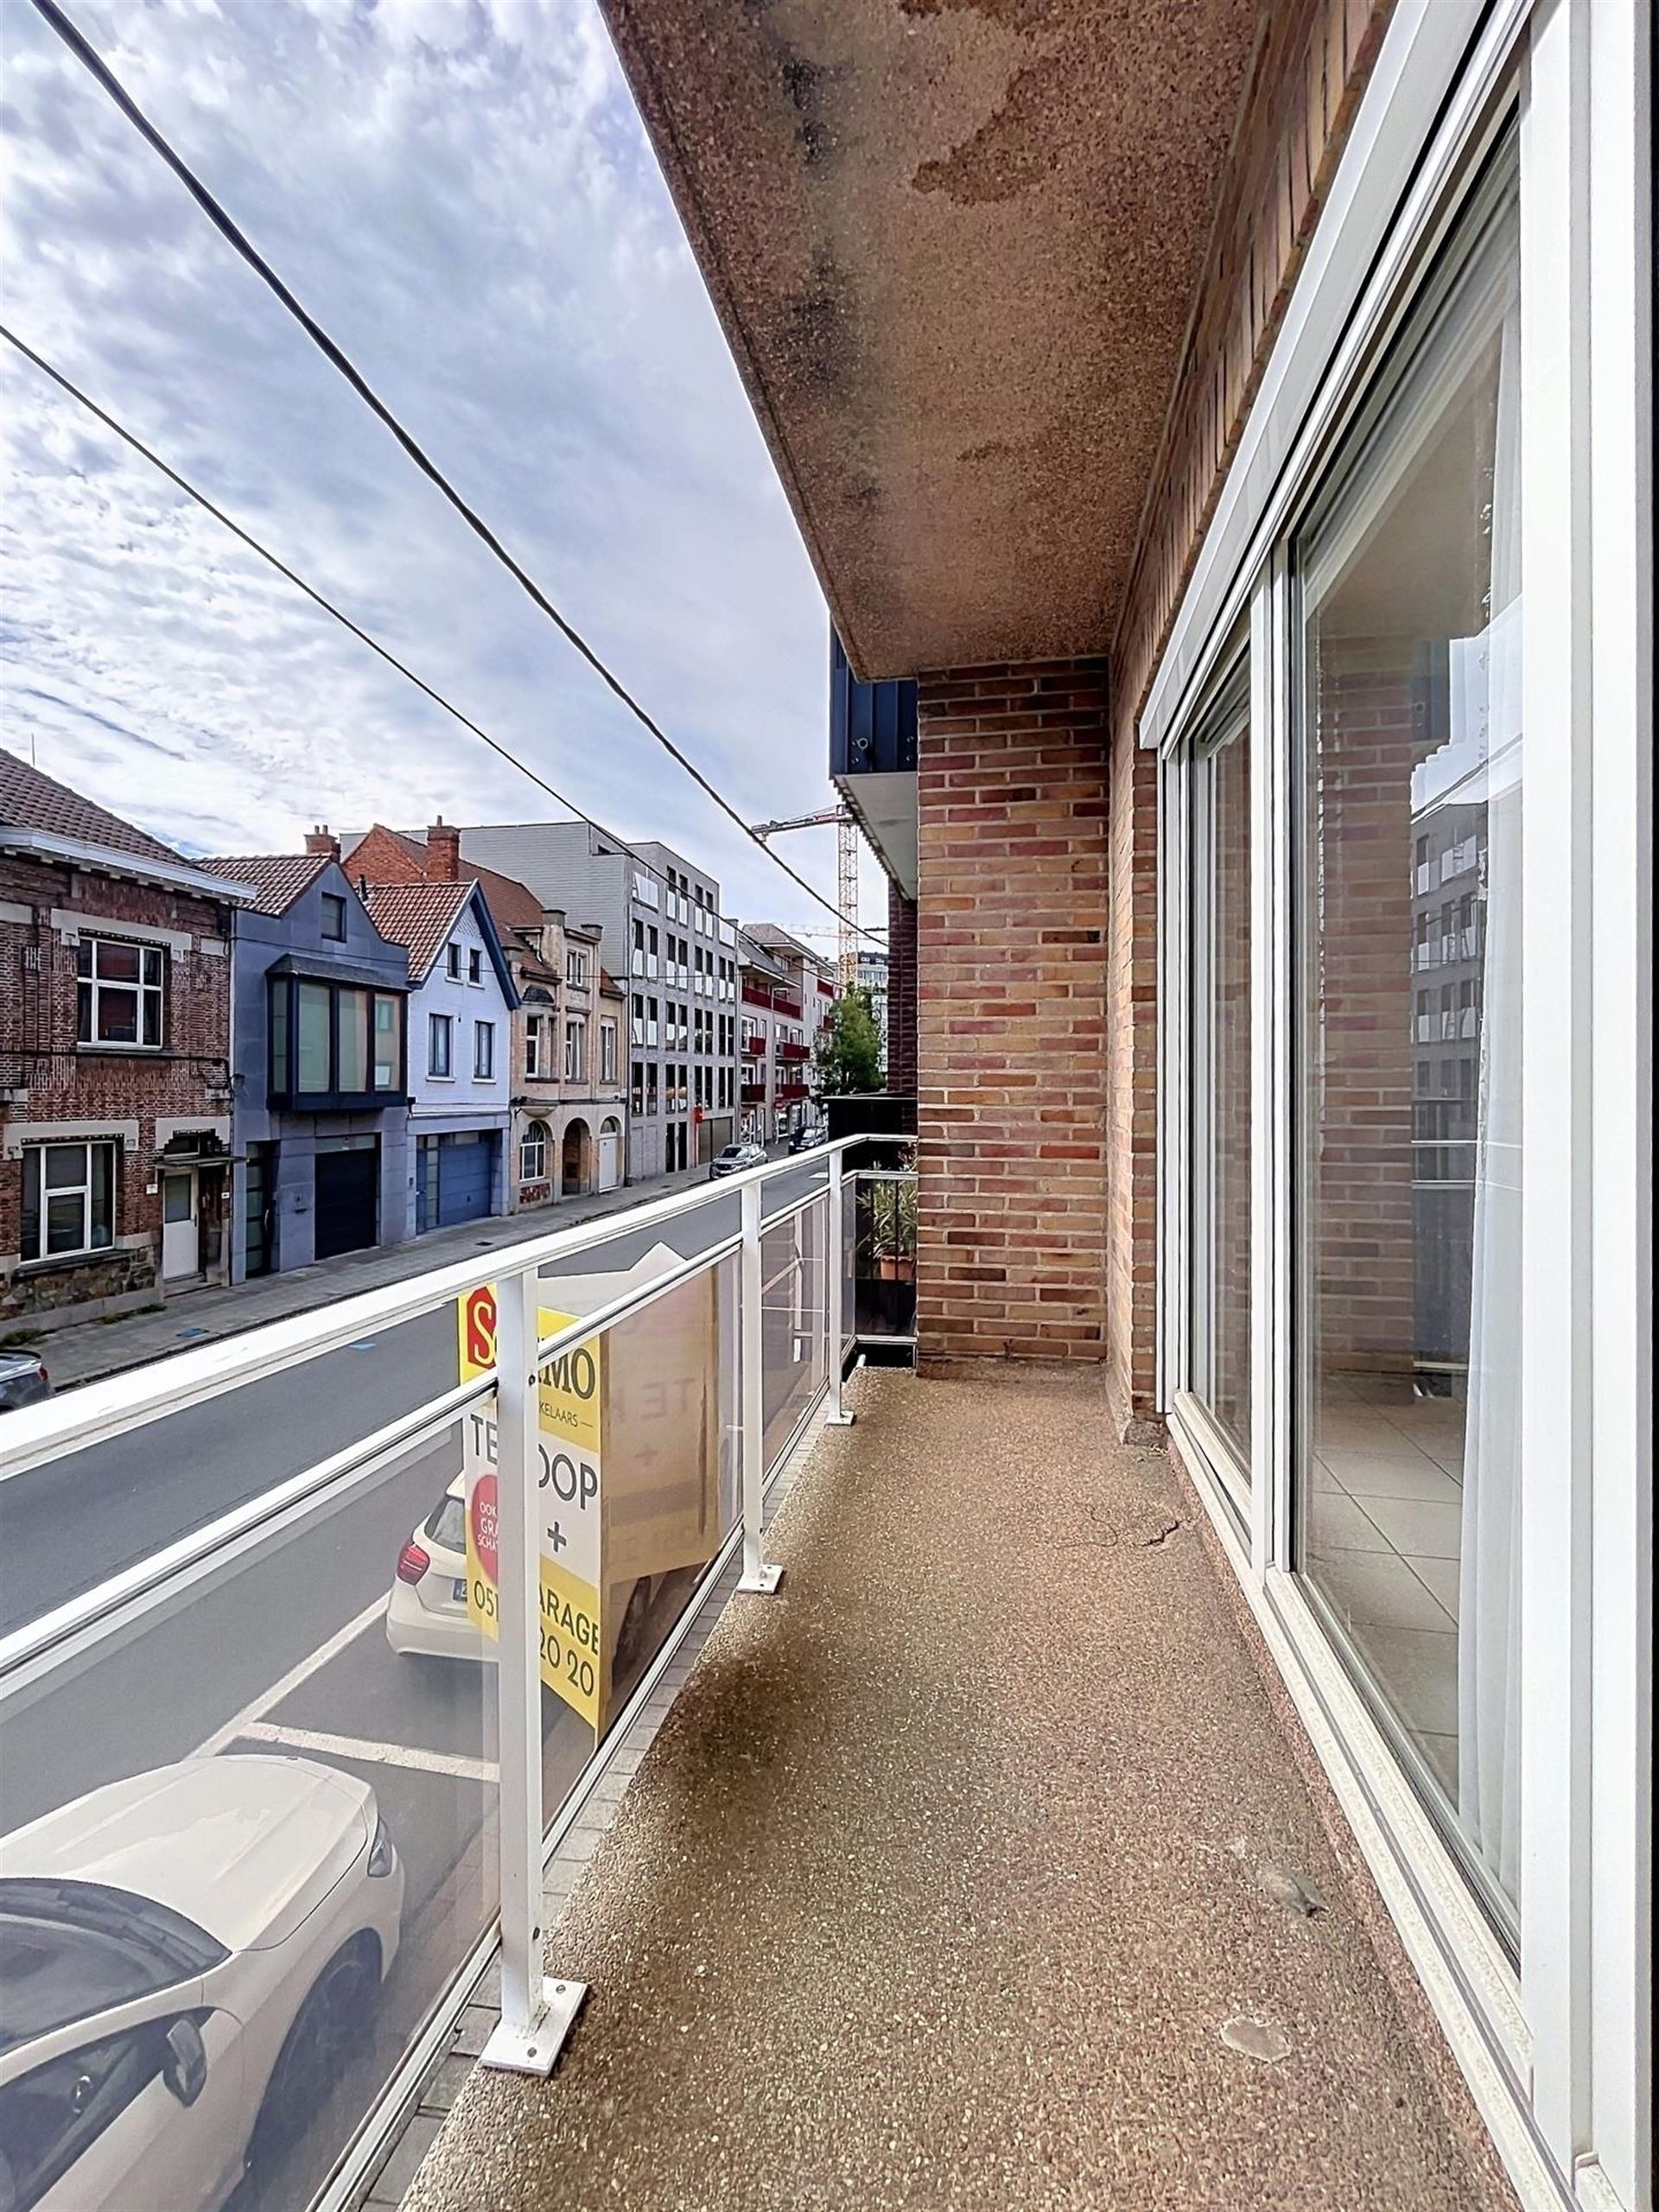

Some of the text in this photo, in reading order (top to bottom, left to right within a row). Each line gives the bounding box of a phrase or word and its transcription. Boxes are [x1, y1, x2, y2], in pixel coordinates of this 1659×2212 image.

[539, 1400, 578, 1427] KELAARS
[470, 1414, 498, 1465] TE
[567, 1649, 594, 1697] 20
